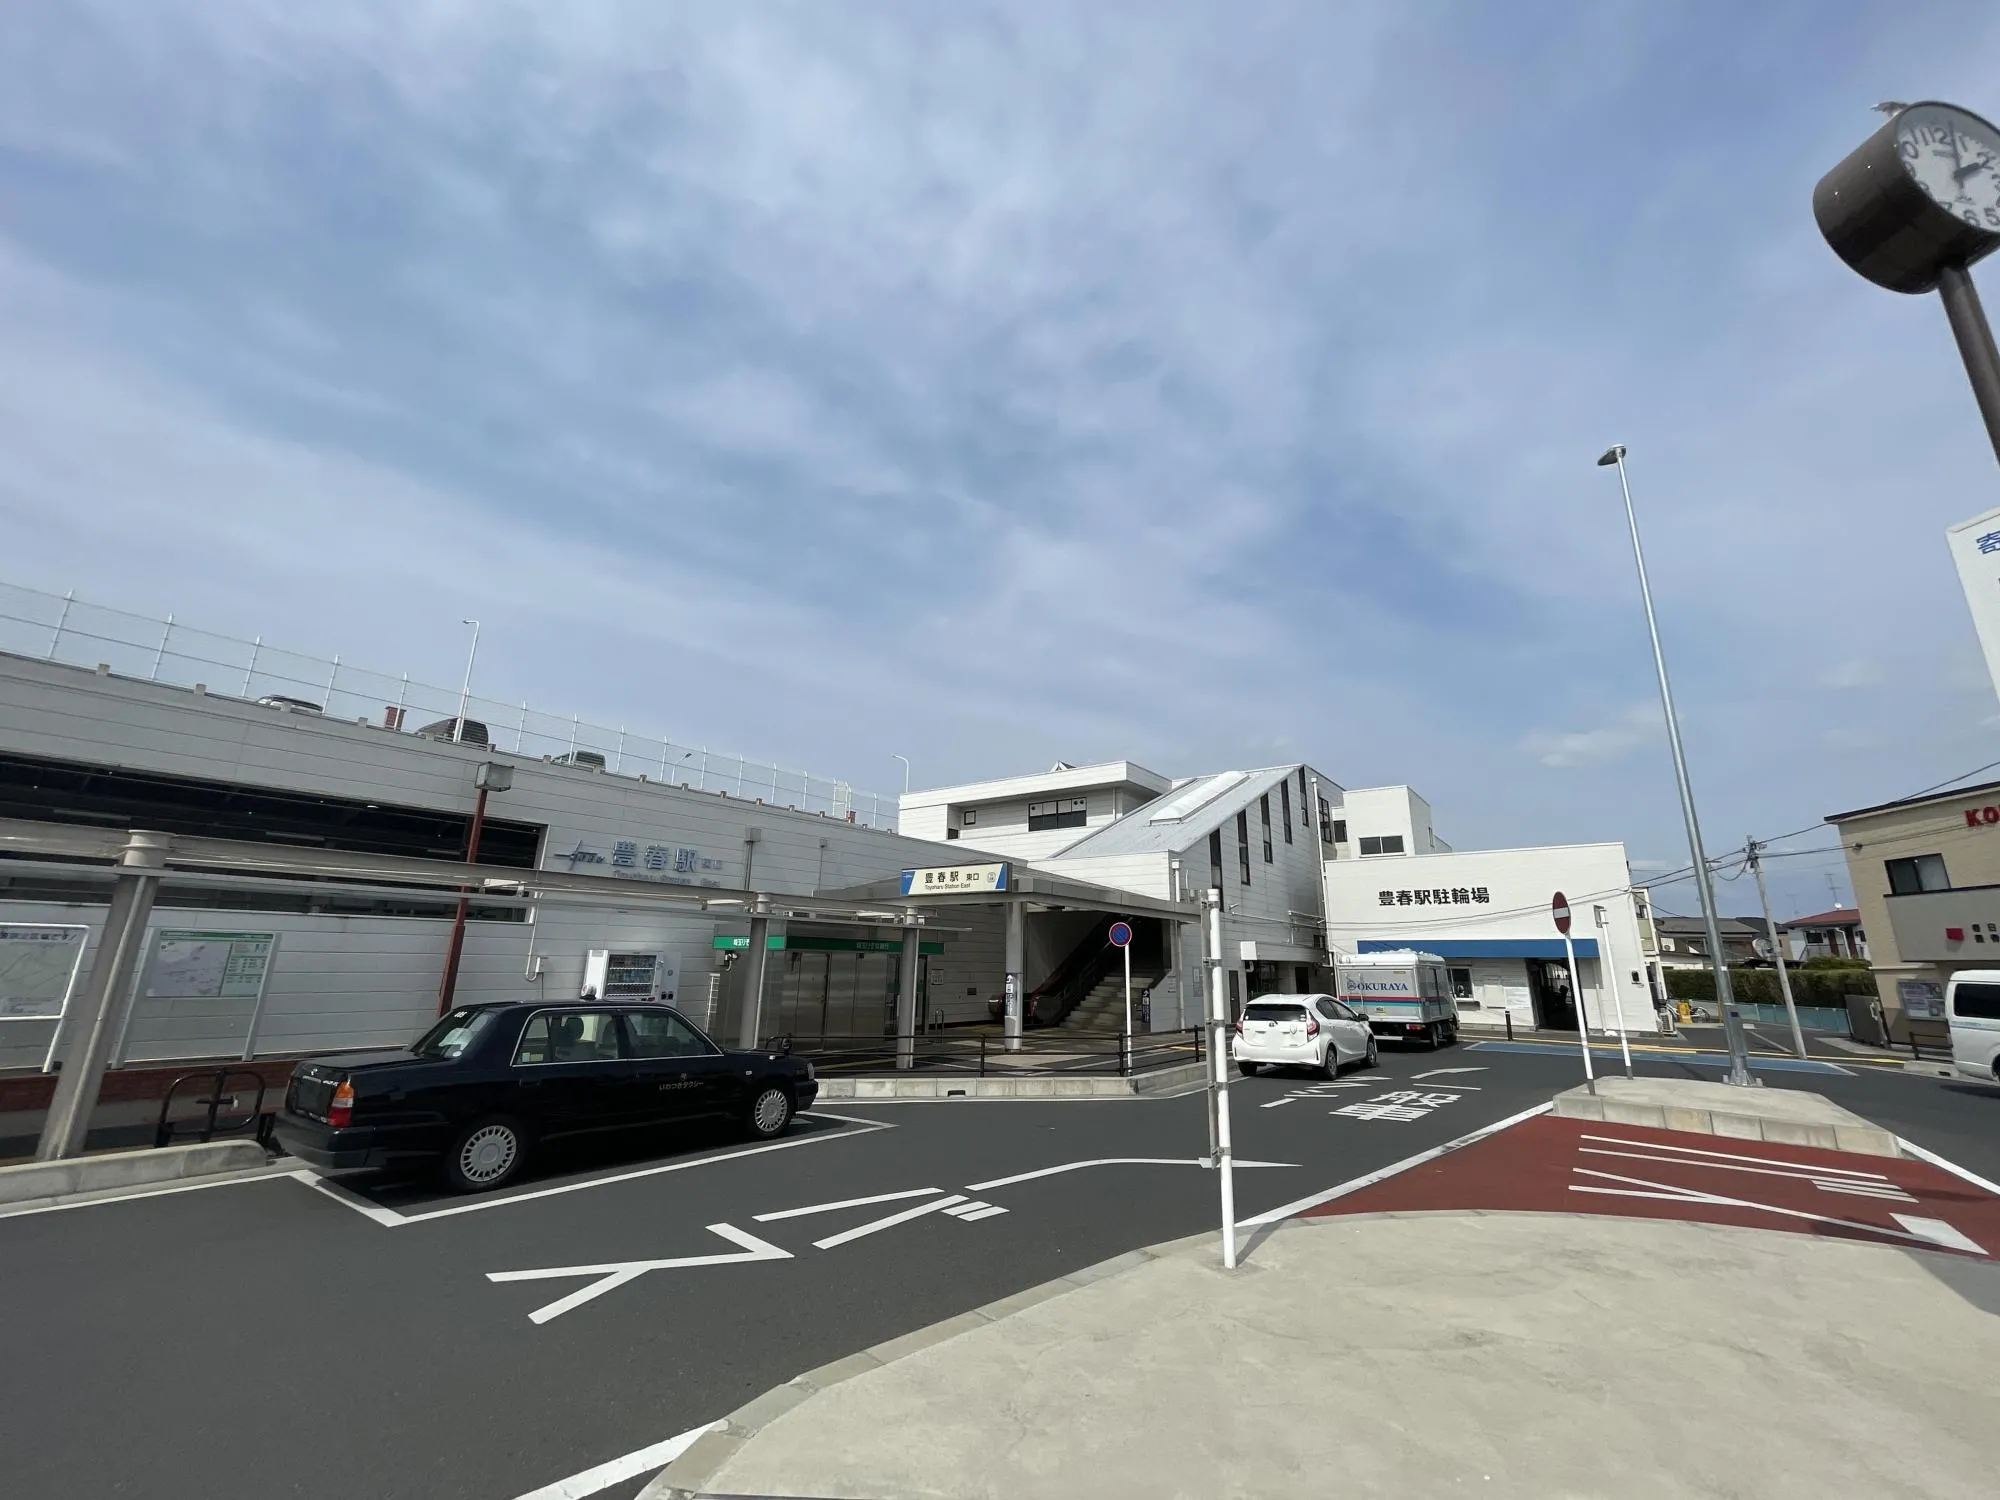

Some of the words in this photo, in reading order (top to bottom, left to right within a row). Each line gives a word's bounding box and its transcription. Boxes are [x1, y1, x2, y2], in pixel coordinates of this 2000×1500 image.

[1964, 805, 2000, 827] KO
[612, 840, 699, 873] 豊春駅
[925, 870, 959, 884] 豊春駅
[966, 873, 980, 881] 東口
[1378, 887, 1490, 906] 豊春駅駐輪場
[1357, 982, 1408, 991] OKURAYA
